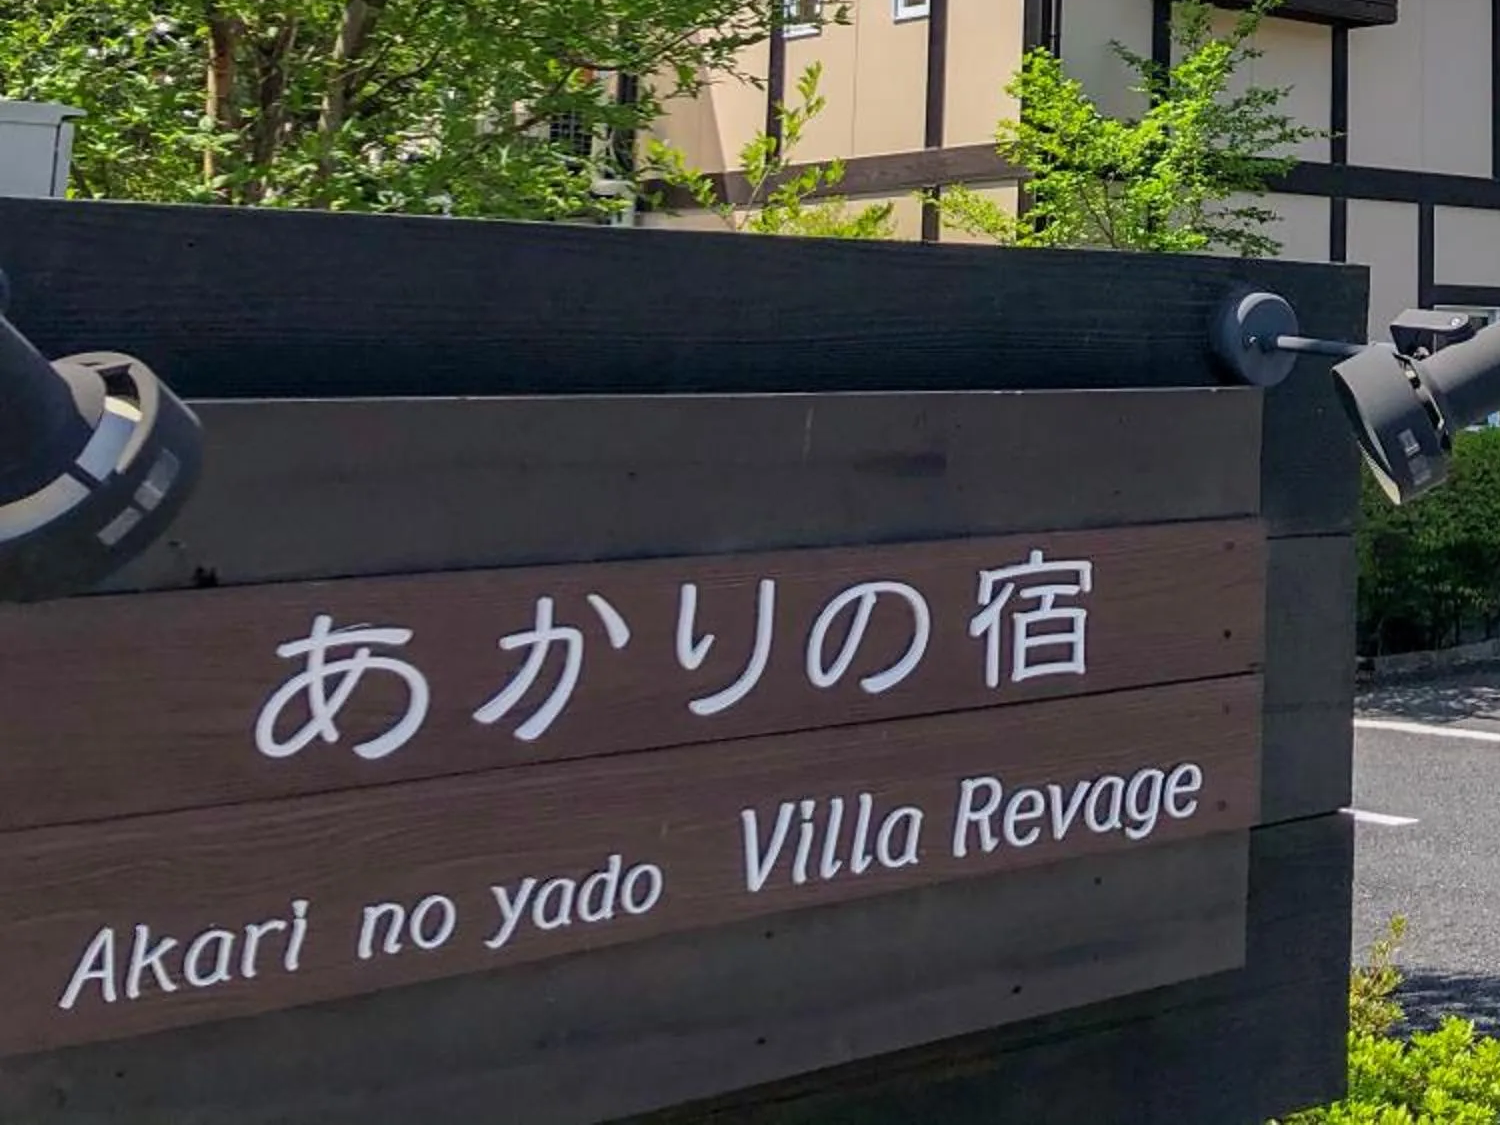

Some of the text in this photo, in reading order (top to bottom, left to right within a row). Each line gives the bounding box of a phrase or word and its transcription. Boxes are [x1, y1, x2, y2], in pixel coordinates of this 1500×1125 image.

[255, 549, 1092, 761] あかりの宿
[58, 762, 1203, 1010] Akari no yado Villa Revage
